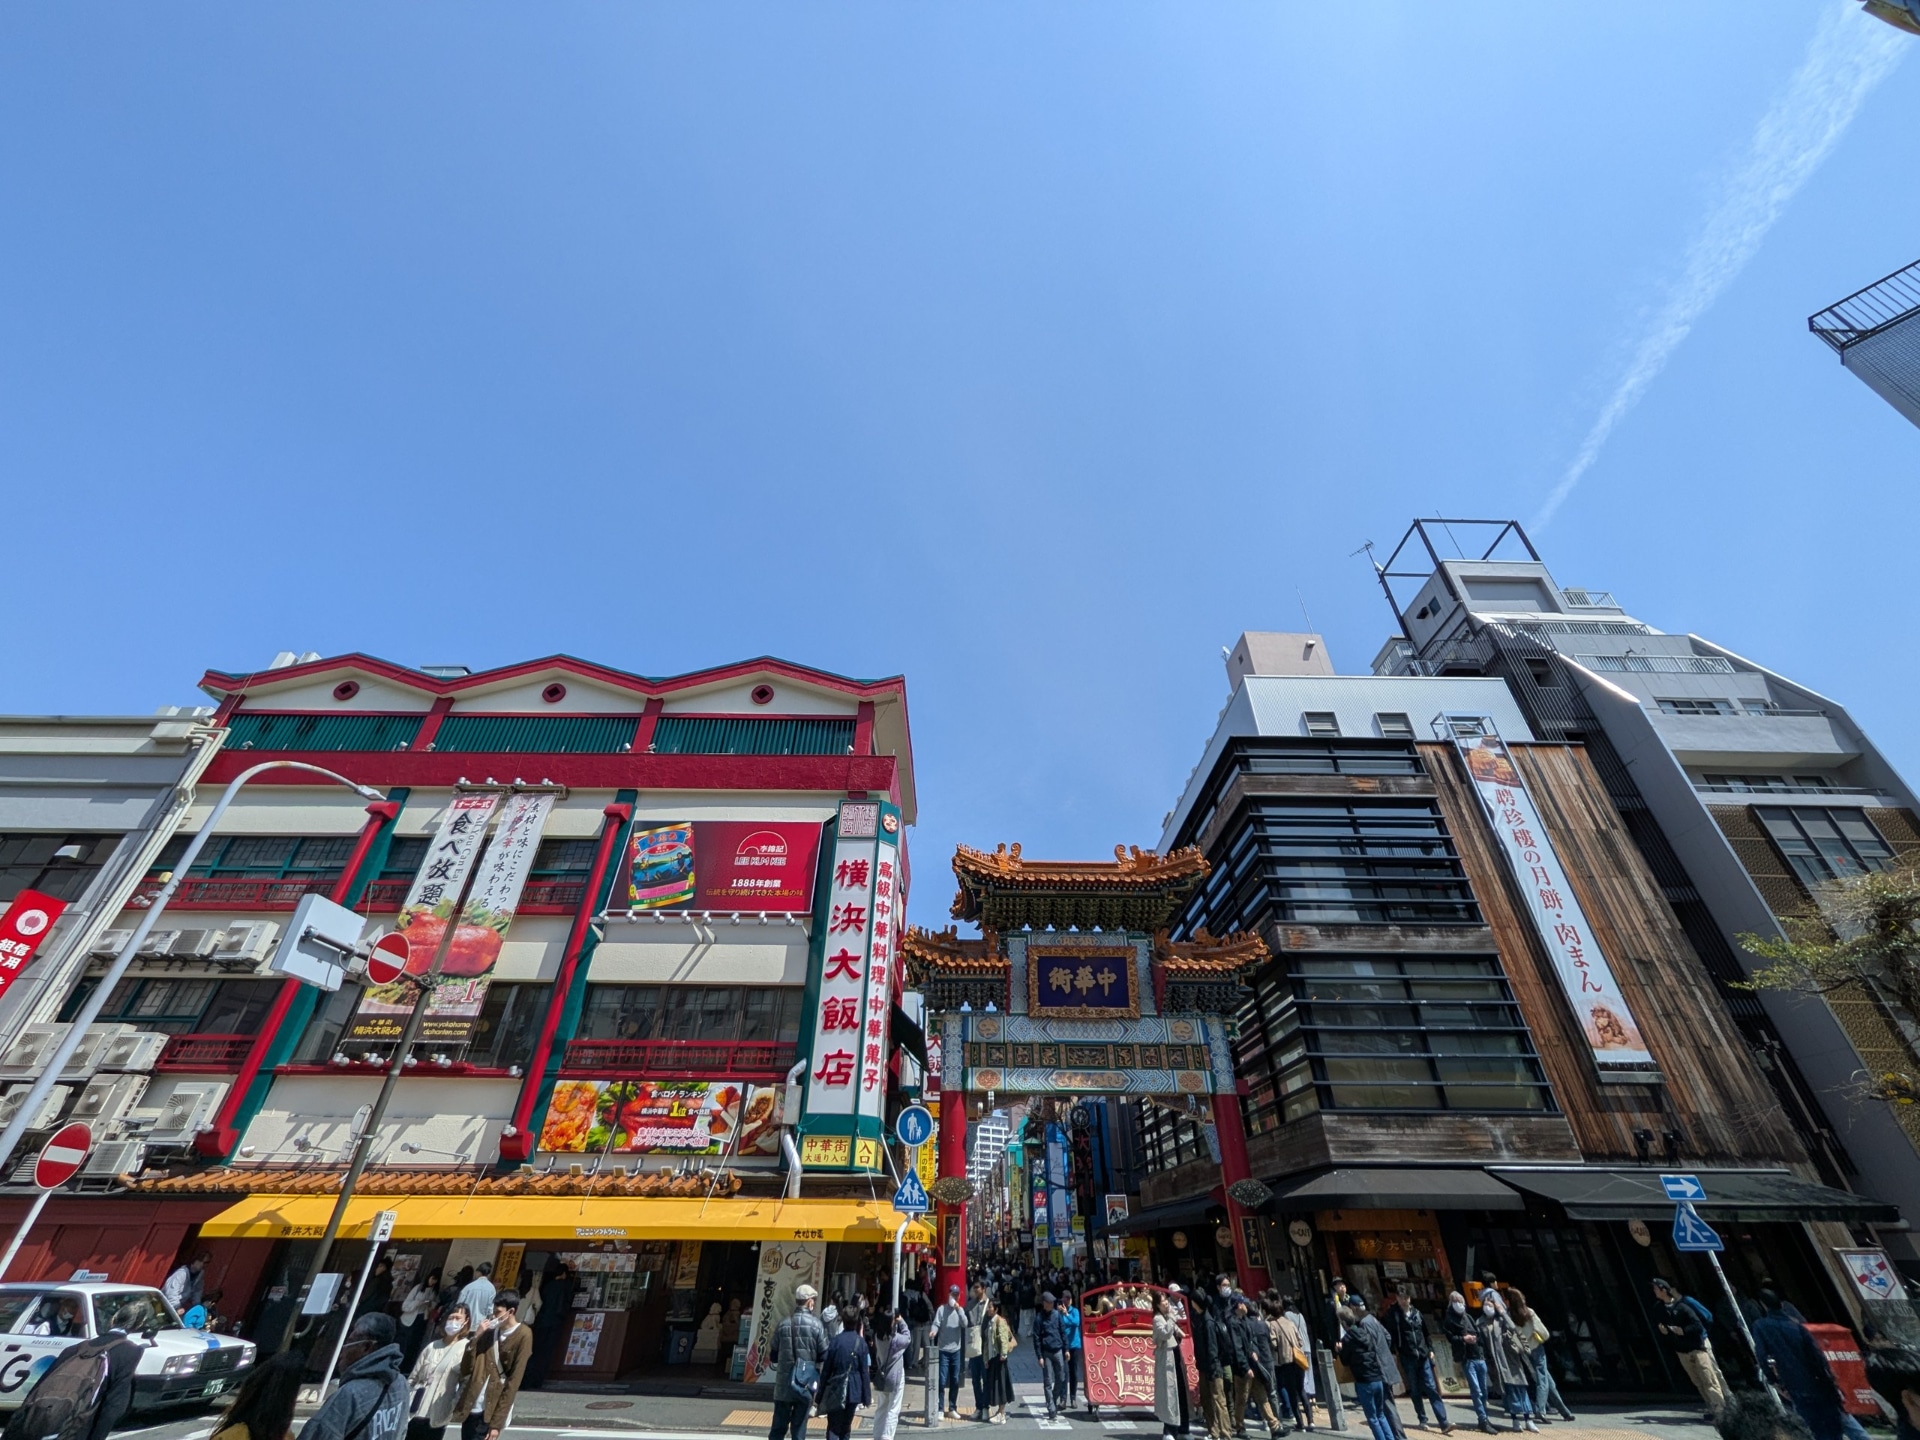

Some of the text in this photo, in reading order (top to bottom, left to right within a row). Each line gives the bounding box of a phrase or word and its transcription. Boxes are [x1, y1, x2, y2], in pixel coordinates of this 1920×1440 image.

[457, 801, 491, 809] オーダー式
[416, 812, 472, 906] 食べ放題
[491, 802, 541, 916] 素材と味にこだわった
[734, 857, 787, 866] LEE KUM KEE
[731, 879, 782, 888] 1888年創業
[814, 859, 870, 1086] 横浜大飯店
[651, 1090, 710, 1098] 食べログ ランキング
[669, 1101, 687, 1117] 1位
[806, 1138, 848, 1152] 中華街
[859, 1141, 872, 1164] 入口
[805, 1155, 847, 1163] 大通り入口
[383, 1213, 395, 1221] TAXI
[281, 1226, 326, 1236] 横浜大飯
